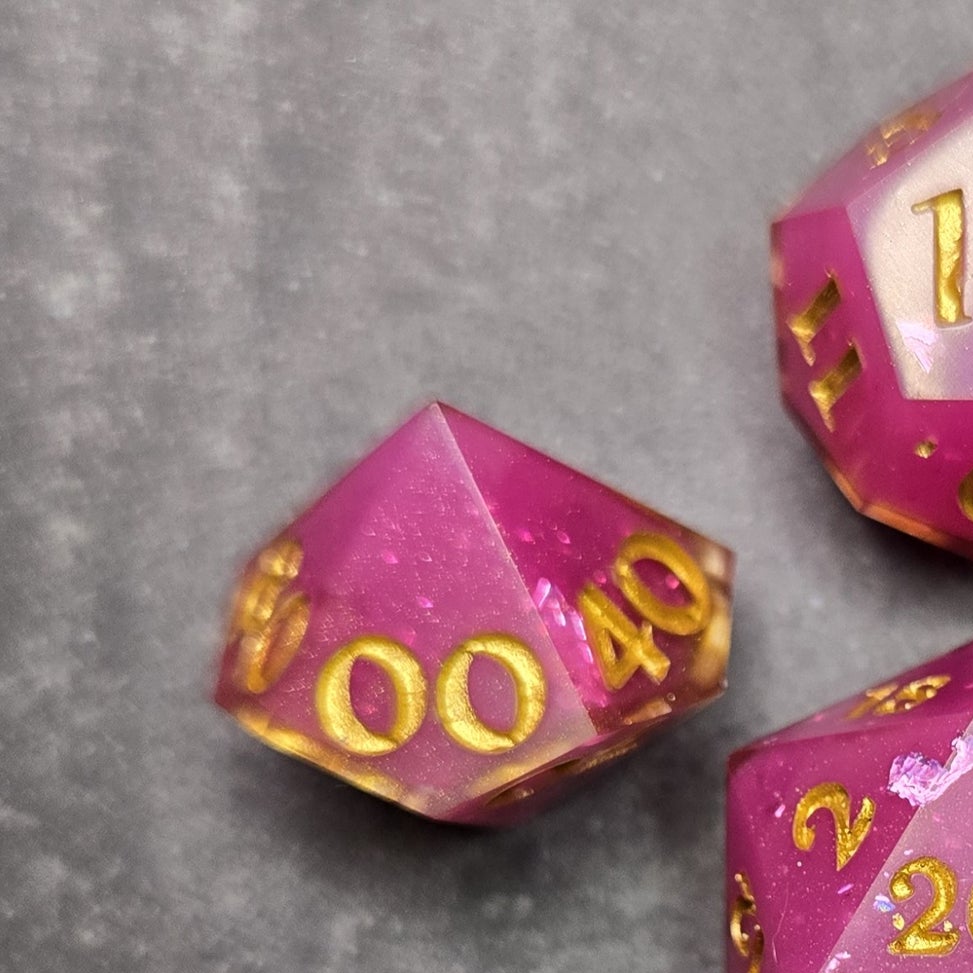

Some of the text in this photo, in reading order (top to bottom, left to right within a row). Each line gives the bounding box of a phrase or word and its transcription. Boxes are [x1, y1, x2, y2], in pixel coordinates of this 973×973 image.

[576, 530, 714, 692] 40
[315, 634, 547, 757] 00
[792, 783, 876, 872] 2
